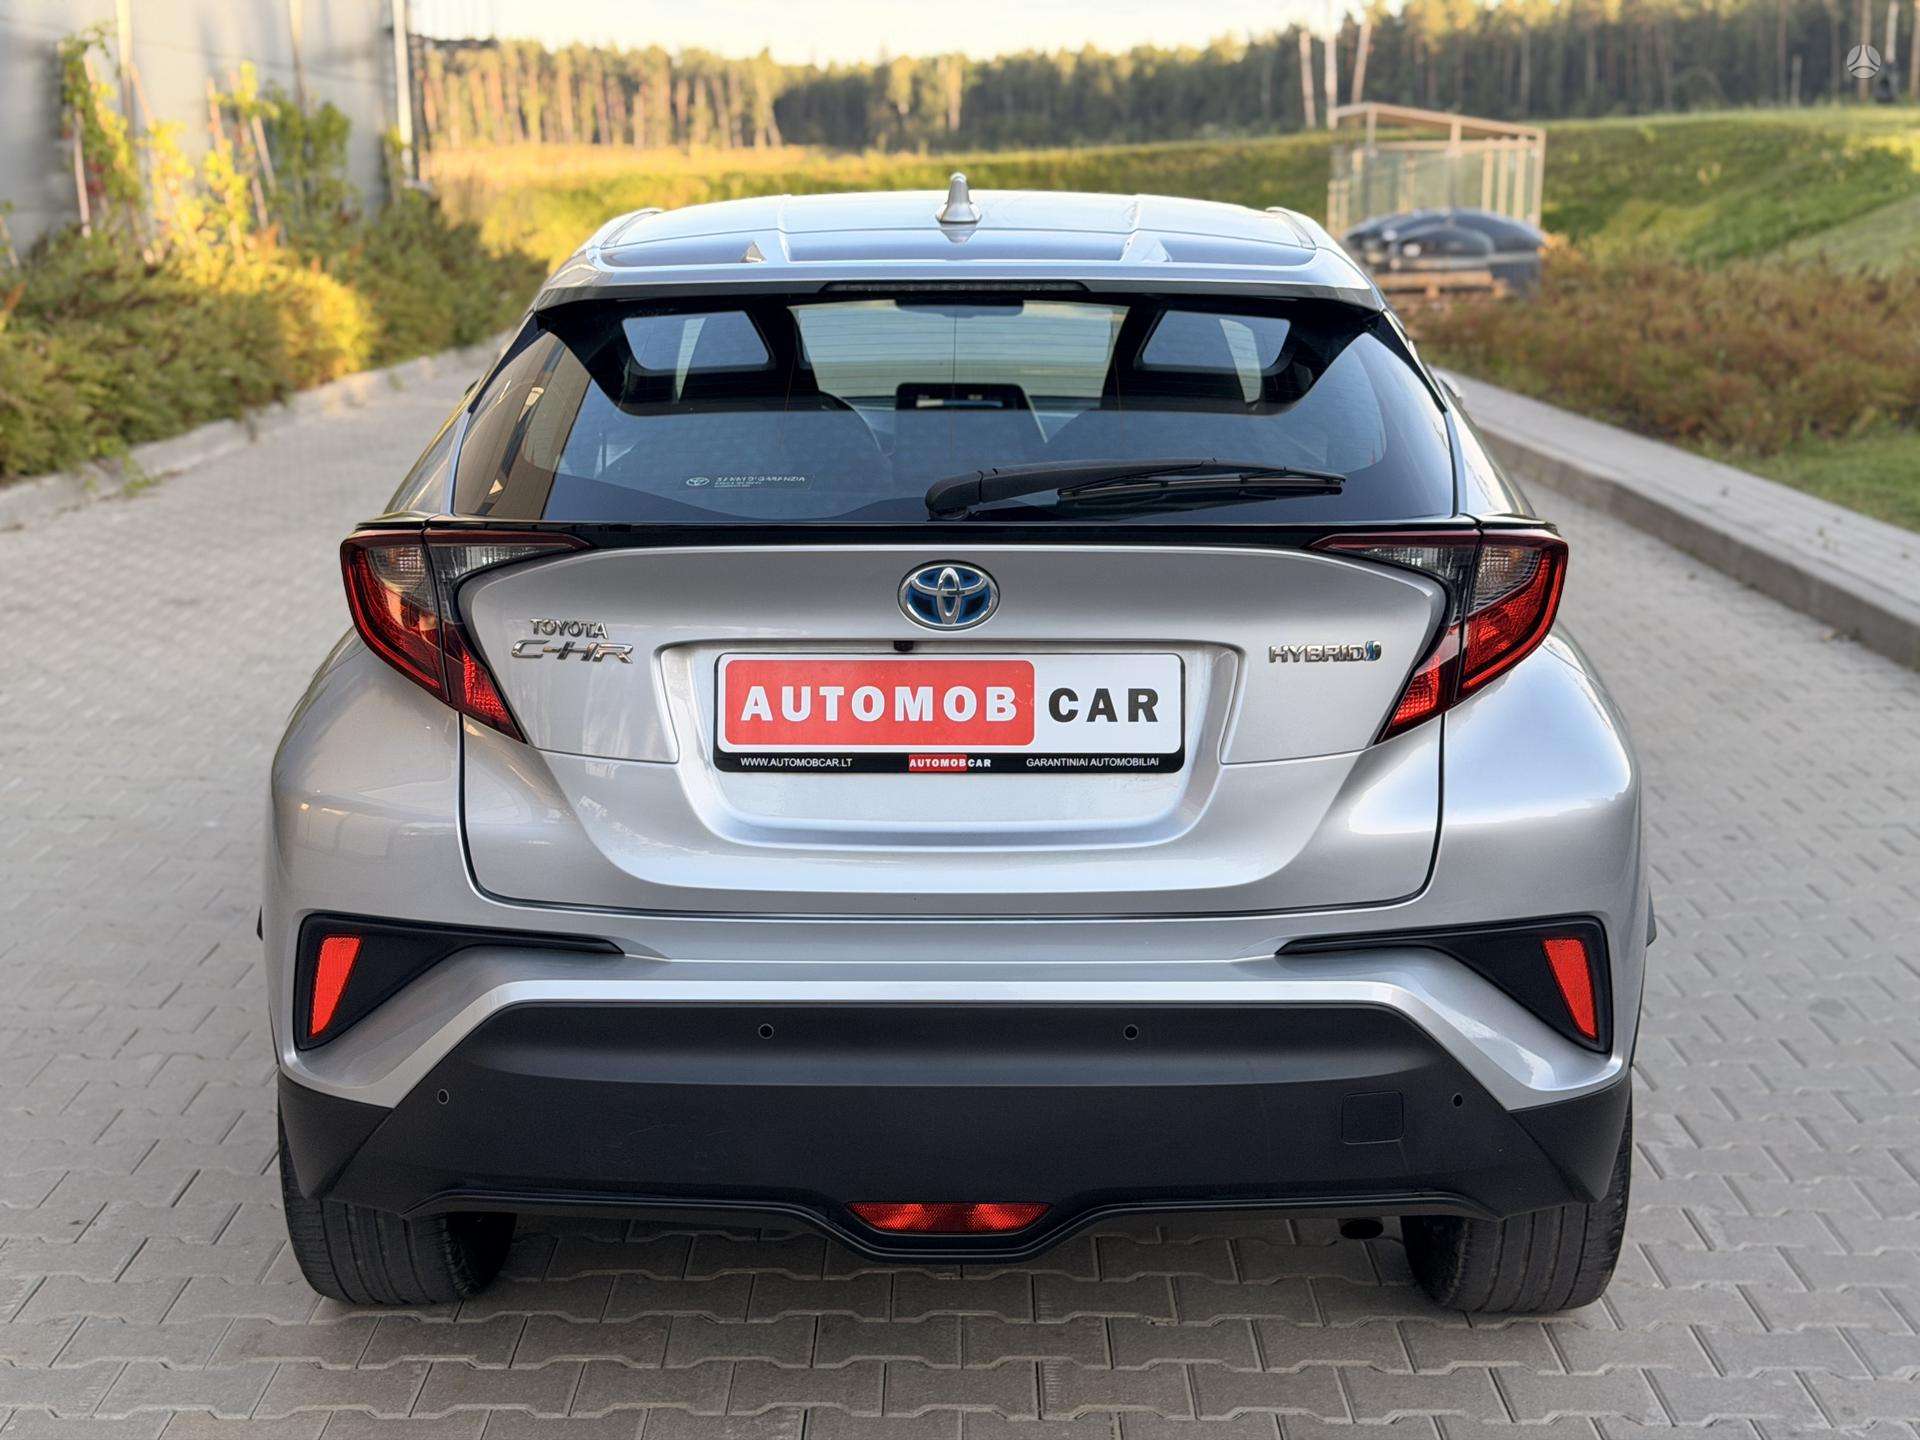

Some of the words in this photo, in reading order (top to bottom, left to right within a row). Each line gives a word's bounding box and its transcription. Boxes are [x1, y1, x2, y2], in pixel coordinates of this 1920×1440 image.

[530, 618, 608, 639] TOYOTA
[511, 640, 633, 664] C-HR
[1268, 644, 1364, 663] HYBRID
[740, 686, 1017, 722] AUTOMOB
[1048, 687, 1159, 723] CAR
[740, 757, 853, 767] WWW.AUTOMOBCAR.LT
[1026, 758, 1089, 767] GARANTINIAI
[1089, 757, 1159, 767] AUTOMOBILIAI
